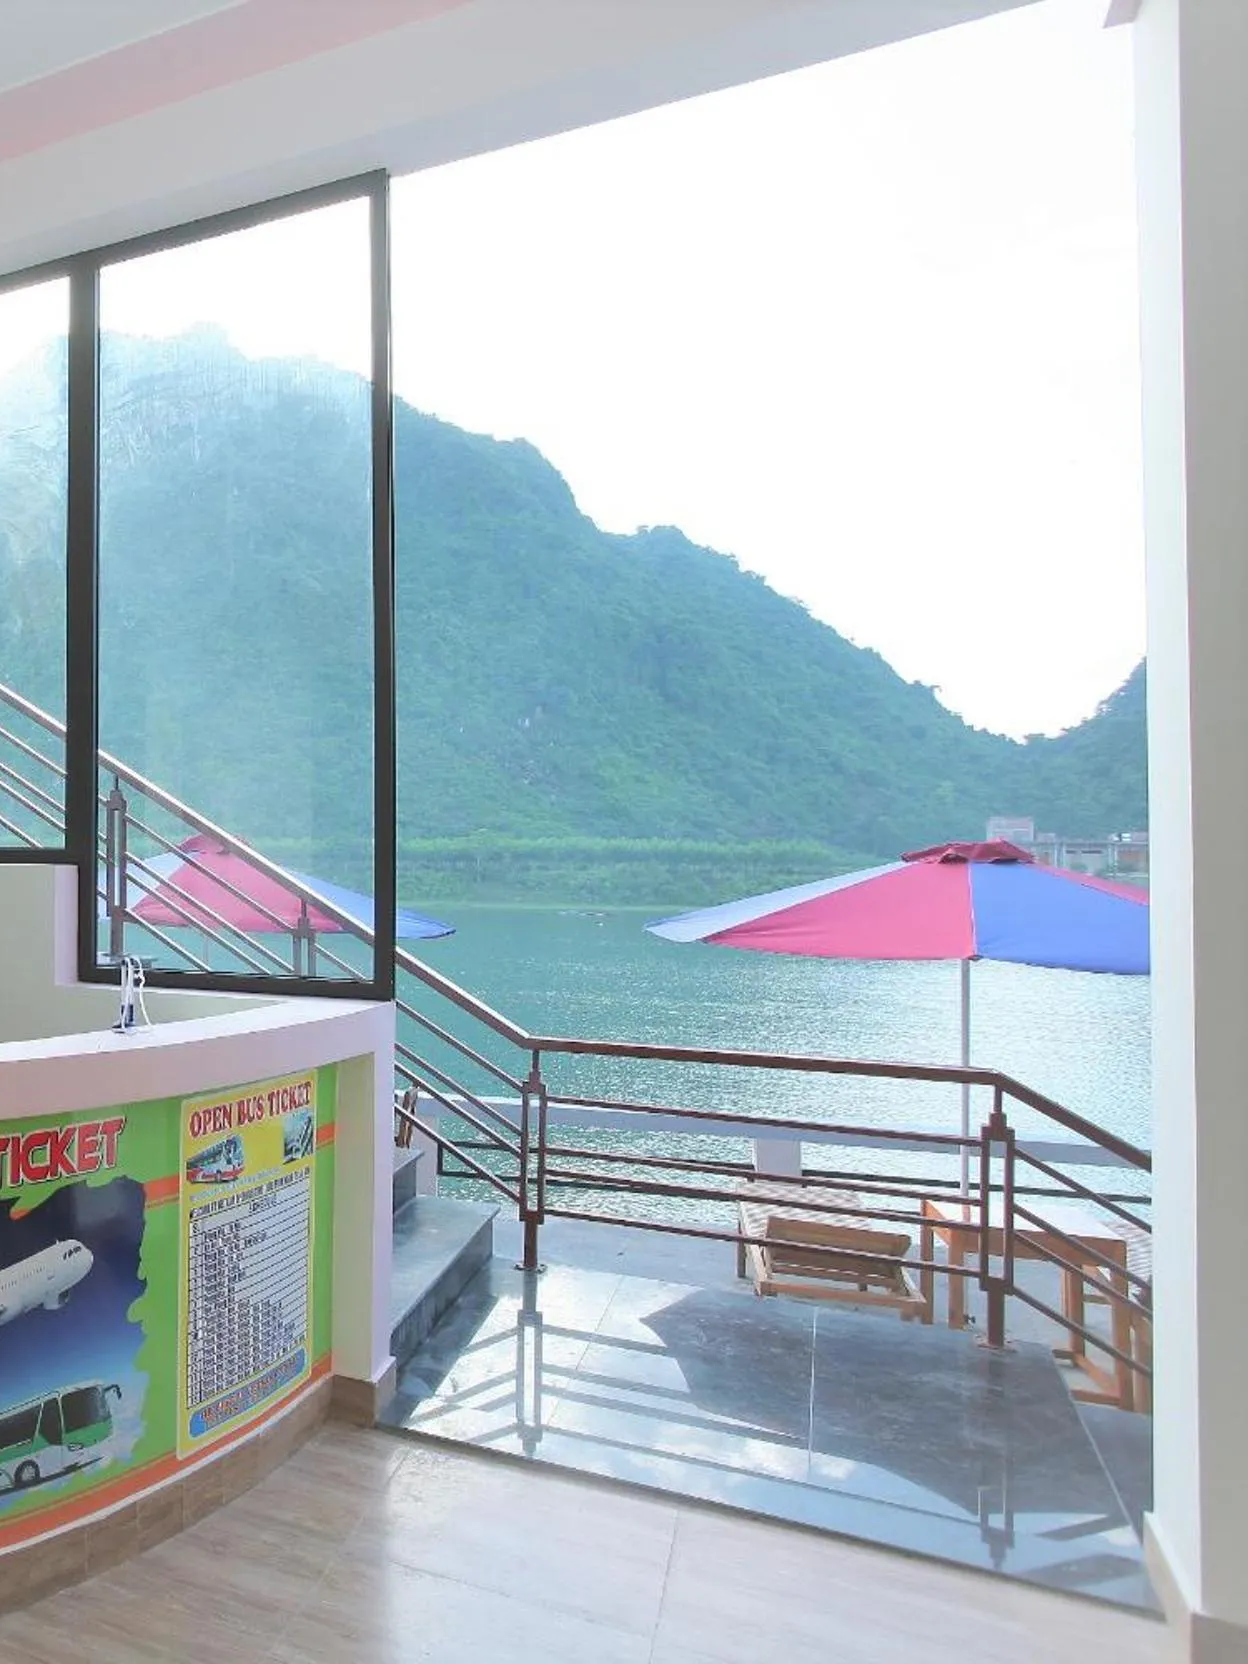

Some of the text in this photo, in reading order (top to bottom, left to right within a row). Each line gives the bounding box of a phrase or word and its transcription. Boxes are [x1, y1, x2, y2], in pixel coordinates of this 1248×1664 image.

[189, 1081, 312, 1138] OPEN BUS TICKET
